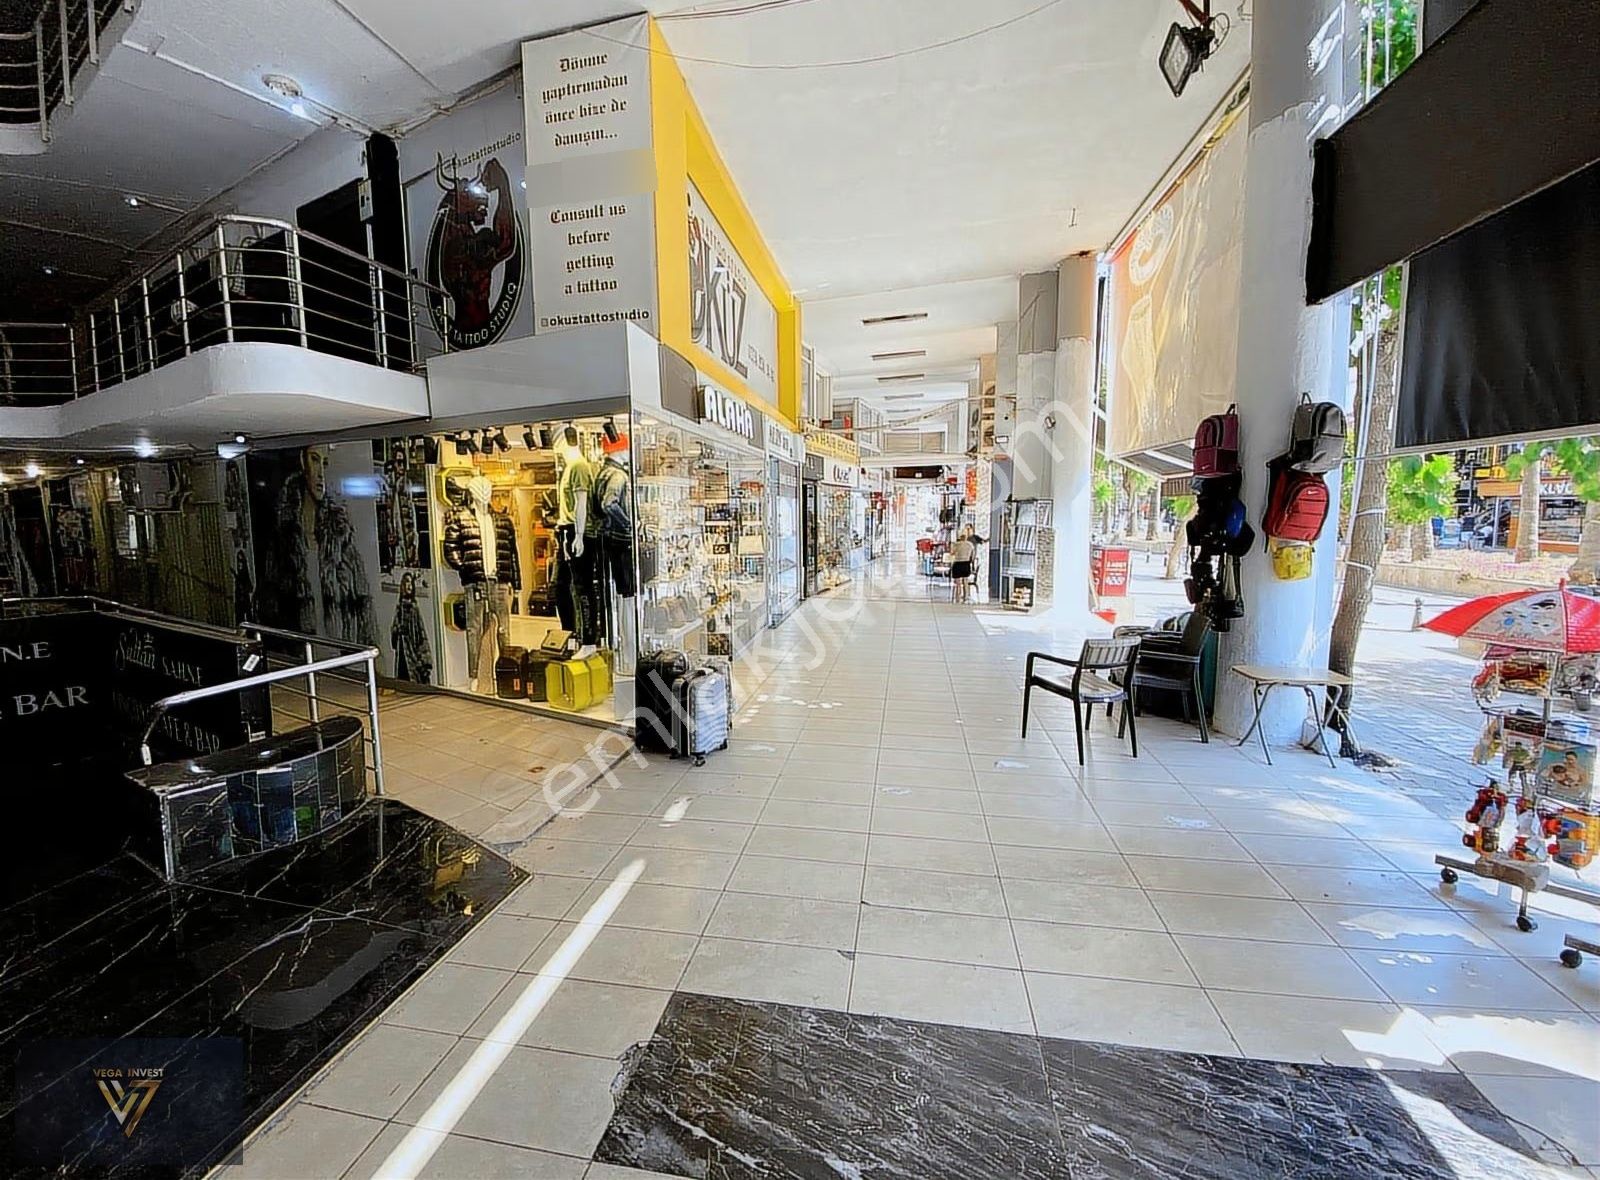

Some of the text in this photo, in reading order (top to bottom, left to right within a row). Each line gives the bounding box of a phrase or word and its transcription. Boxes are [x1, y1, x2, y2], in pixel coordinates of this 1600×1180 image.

[559, 54, 608, 72] Dövme
[579, 102, 606, 118] bize
[611, 99, 627, 112] de
[550, 204, 626, 224] Consult us
[568, 230, 611, 246] before
[566, 254, 614, 273] getting
[565, 279, 617, 294] a tattoo
[489, 282, 517, 333] STUDIO
[12, 686, 89, 715] BAR
